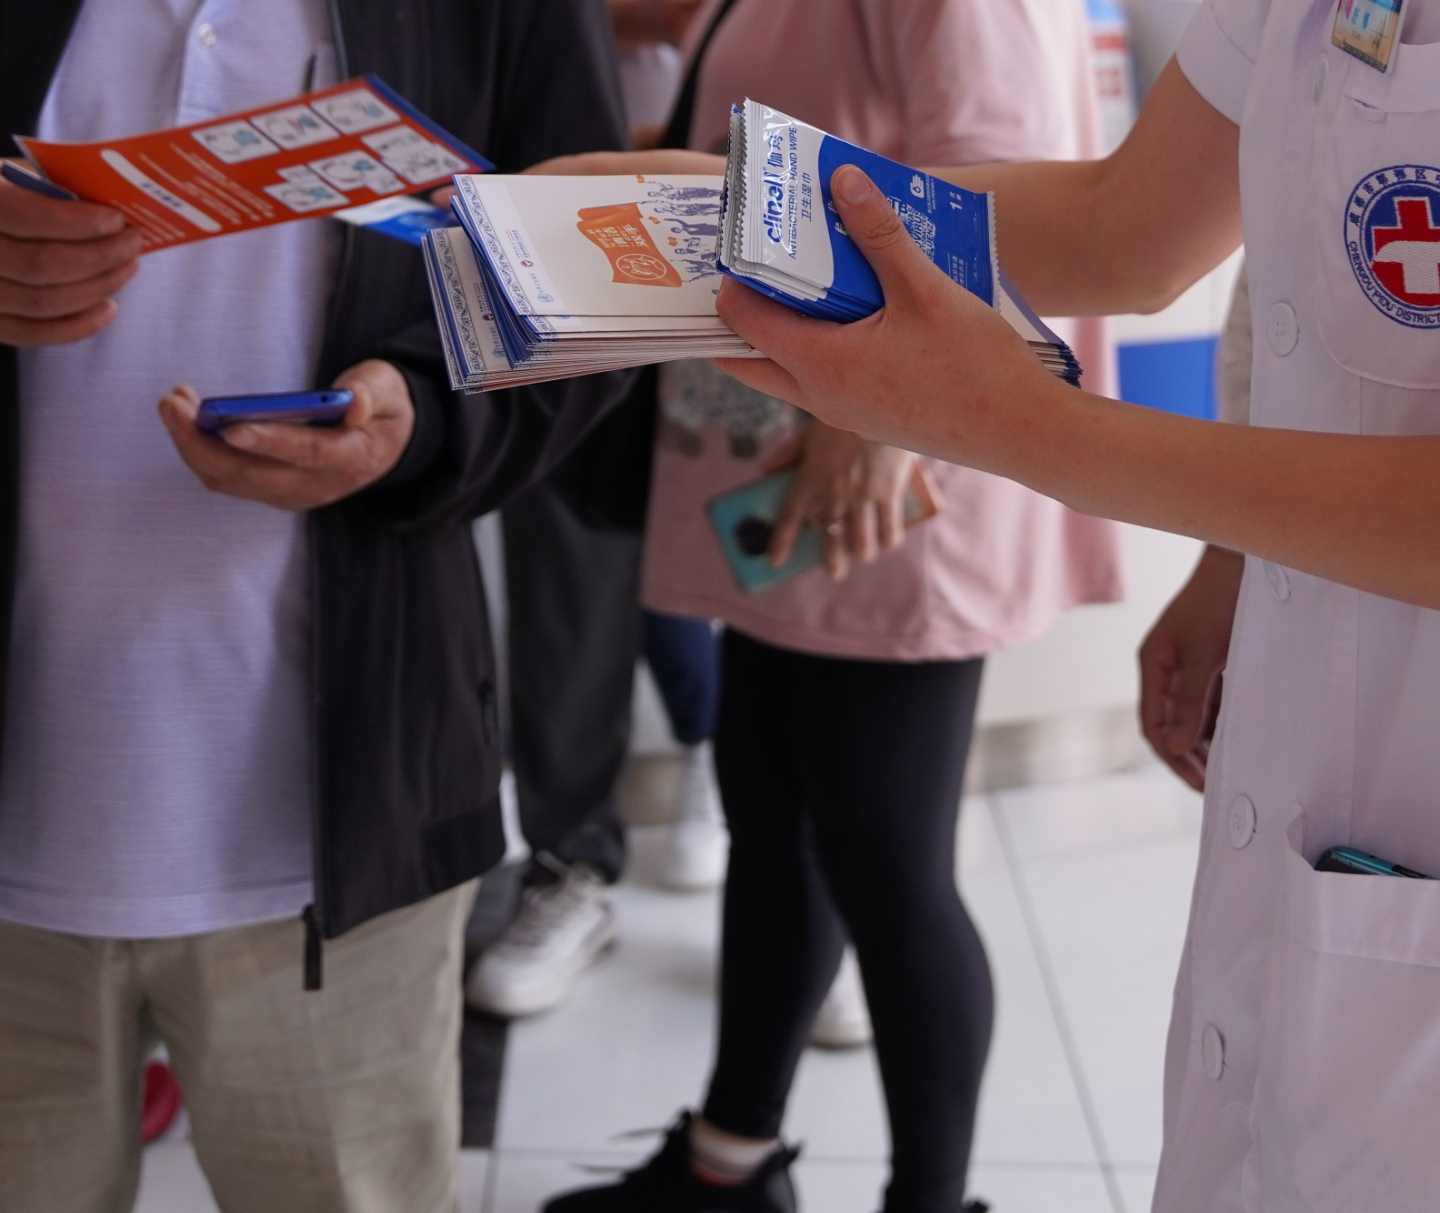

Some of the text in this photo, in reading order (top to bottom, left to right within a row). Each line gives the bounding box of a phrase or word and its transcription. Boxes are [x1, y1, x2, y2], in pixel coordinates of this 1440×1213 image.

[788, 127, 798, 259] ANTIBACTERIAL HAND WIPE
[801, 172, 812, 223] 卫生湿巾
[622, 224, 649, 247] 双手
[1349, 241, 1373, 291] CHENGDU
[1372, 290, 1395, 311] PIDU
[1396, 306, 1440, 324] DISTRICT
